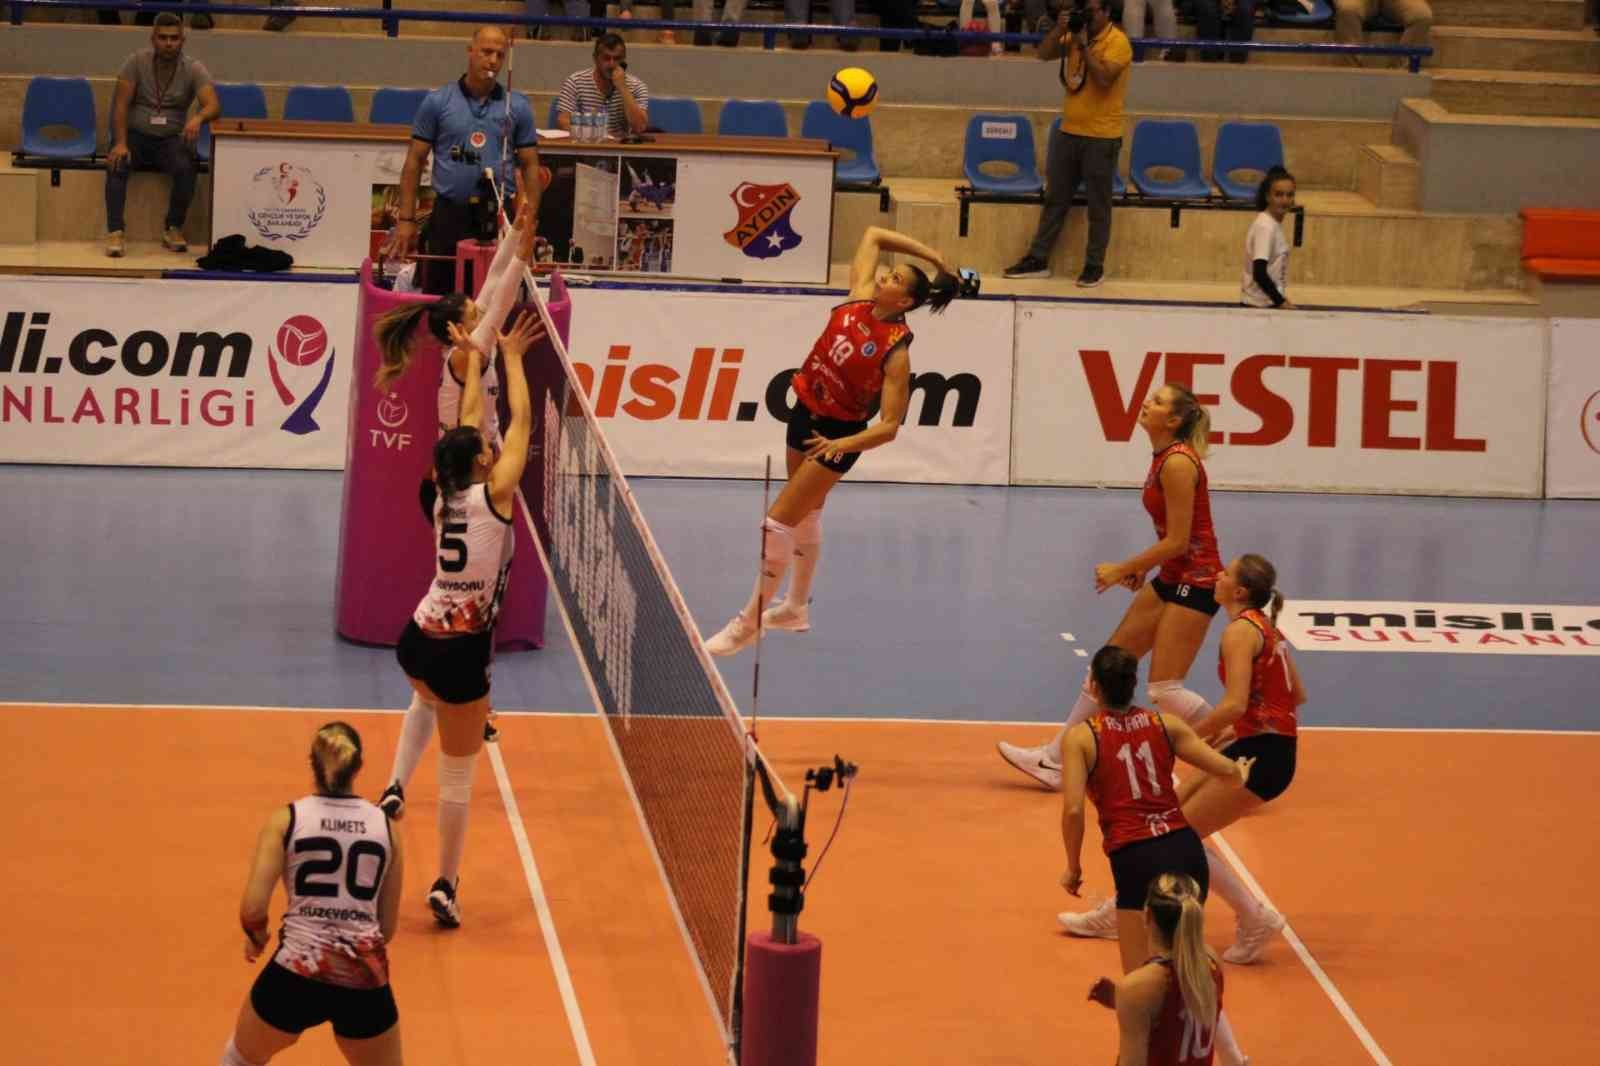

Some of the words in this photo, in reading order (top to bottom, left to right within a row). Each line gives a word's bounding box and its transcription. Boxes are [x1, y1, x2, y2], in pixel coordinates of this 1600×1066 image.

[735, 187, 795, 247] AYDIN
[560, 345, 982, 428] isli.cm
[1077, 349, 1488, 453] VESTEL
[368, 429, 413, 451] TVF
[438, 522, 468, 573] 5
[1176, 583, 1191, 598] 16
[1298, 609, 1600, 631] misli.
[1115, 741, 1161, 801] 11
[319, 818, 367, 834] KLIMETS
[294, 836, 387, 901] 20
